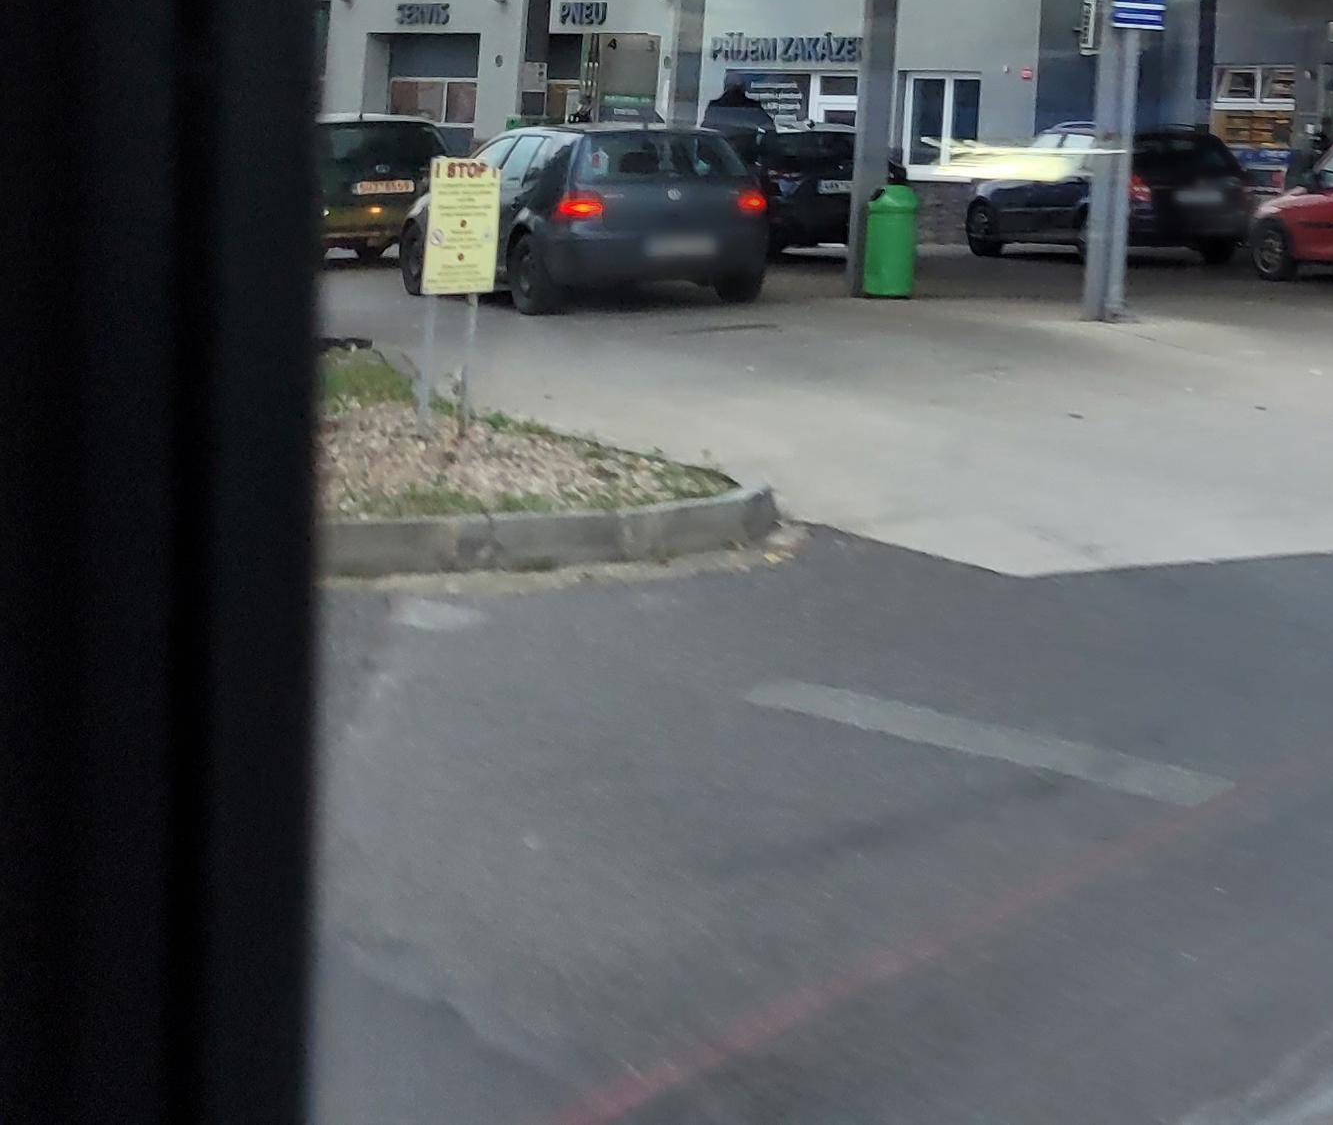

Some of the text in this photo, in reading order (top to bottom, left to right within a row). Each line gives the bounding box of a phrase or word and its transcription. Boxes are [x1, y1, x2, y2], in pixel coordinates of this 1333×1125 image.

[397, 3, 450, 25] SERVIS
[560, 2, 607, 25] PNEU
[447, 162, 488, 178] STOP
